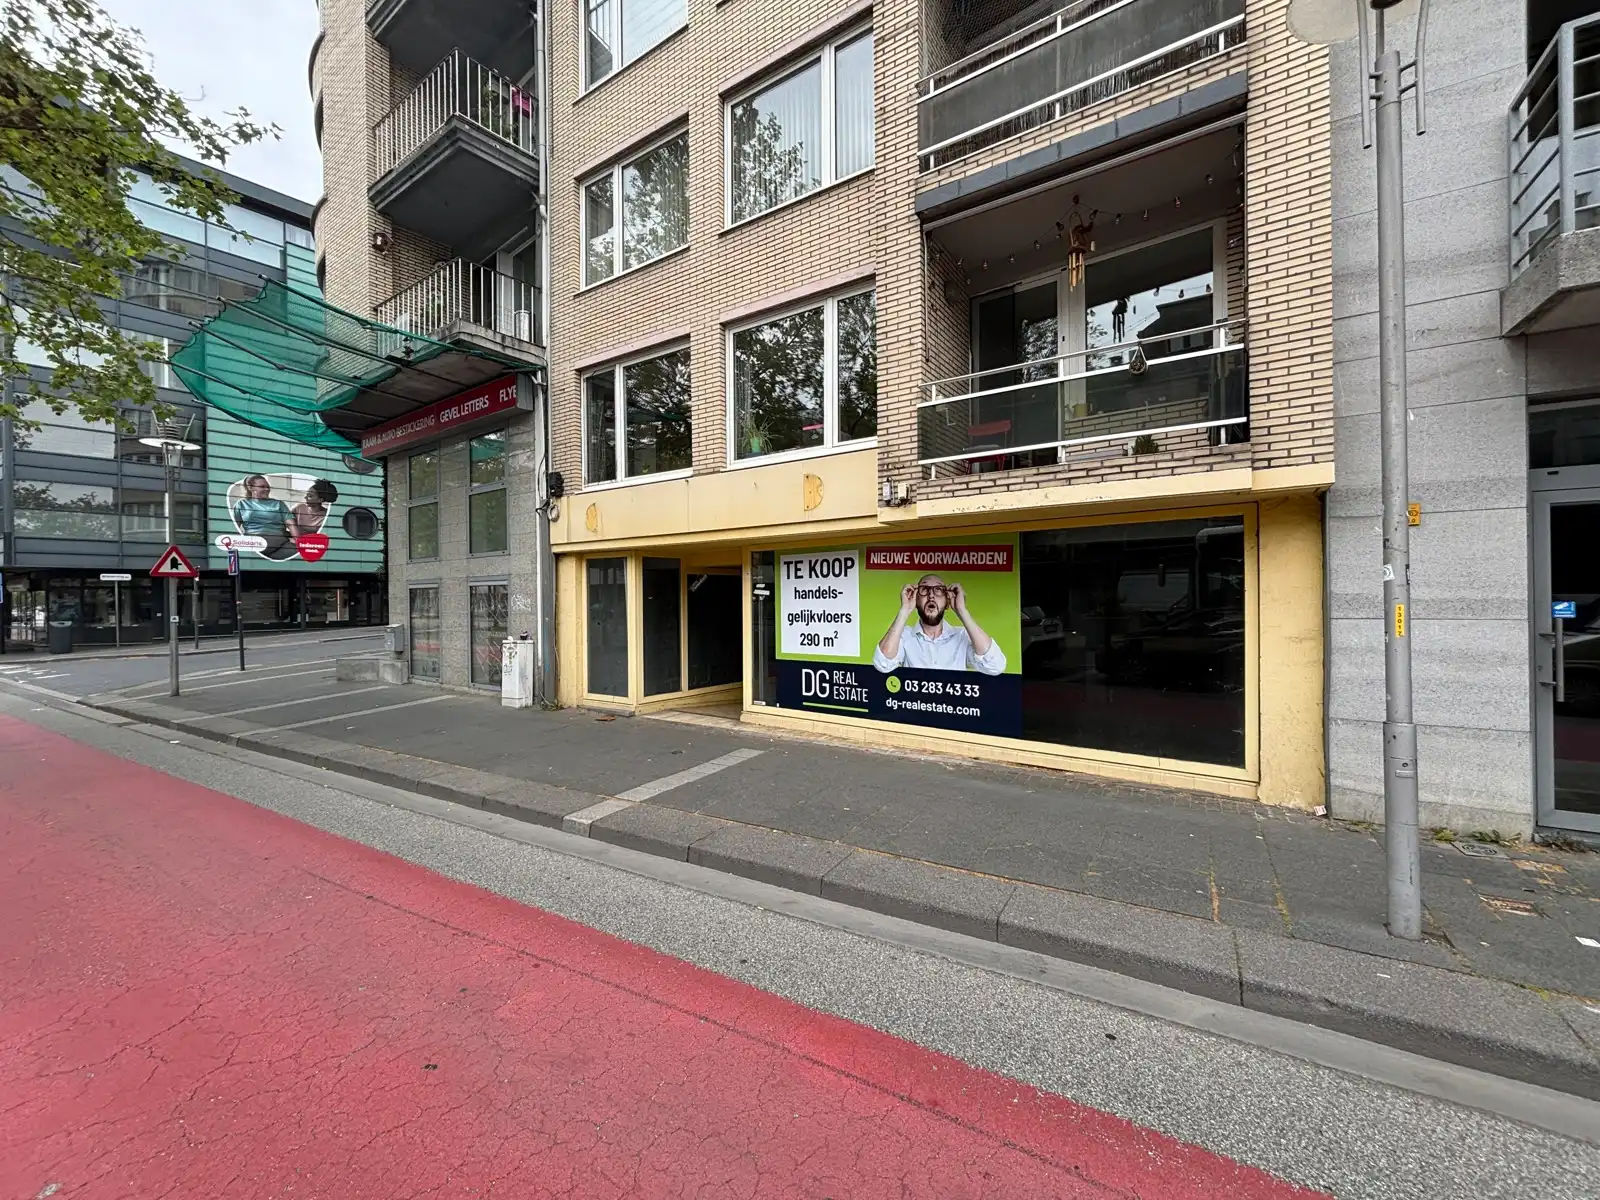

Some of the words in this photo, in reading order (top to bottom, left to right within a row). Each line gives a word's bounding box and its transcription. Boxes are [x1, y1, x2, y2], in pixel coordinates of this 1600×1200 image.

[439, 405, 460, 423] GEVEL
[460, 395, 489, 416] LETTERS
[381, 429, 396, 443] AUTO
[396, 414, 435, 438] BESTICKERING
[870, 552, 911, 565] NIEUWE
[913, 551, 1007, 566] VOORWAARDEN!
[784, 559, 804, 580] TE
[808, 556, 855, 579] KOOP
[794, 586, 844, 600] handels-
[787, 610, 852, 627] gelijkvloers
[800, 633, 820, 647] 290
[801, 668, 830, 698] DG
[833, 670, 858, 686] REAL
[833, 687, 869, 703] ESTATE
[904, 679, 919, 692] 03
[921, 681, 942, 694] 283
[946, 682, 961, 696] 43
[964, 684, 980, 697] 33
[886, 697, 981, 717] dg-realestate.com
